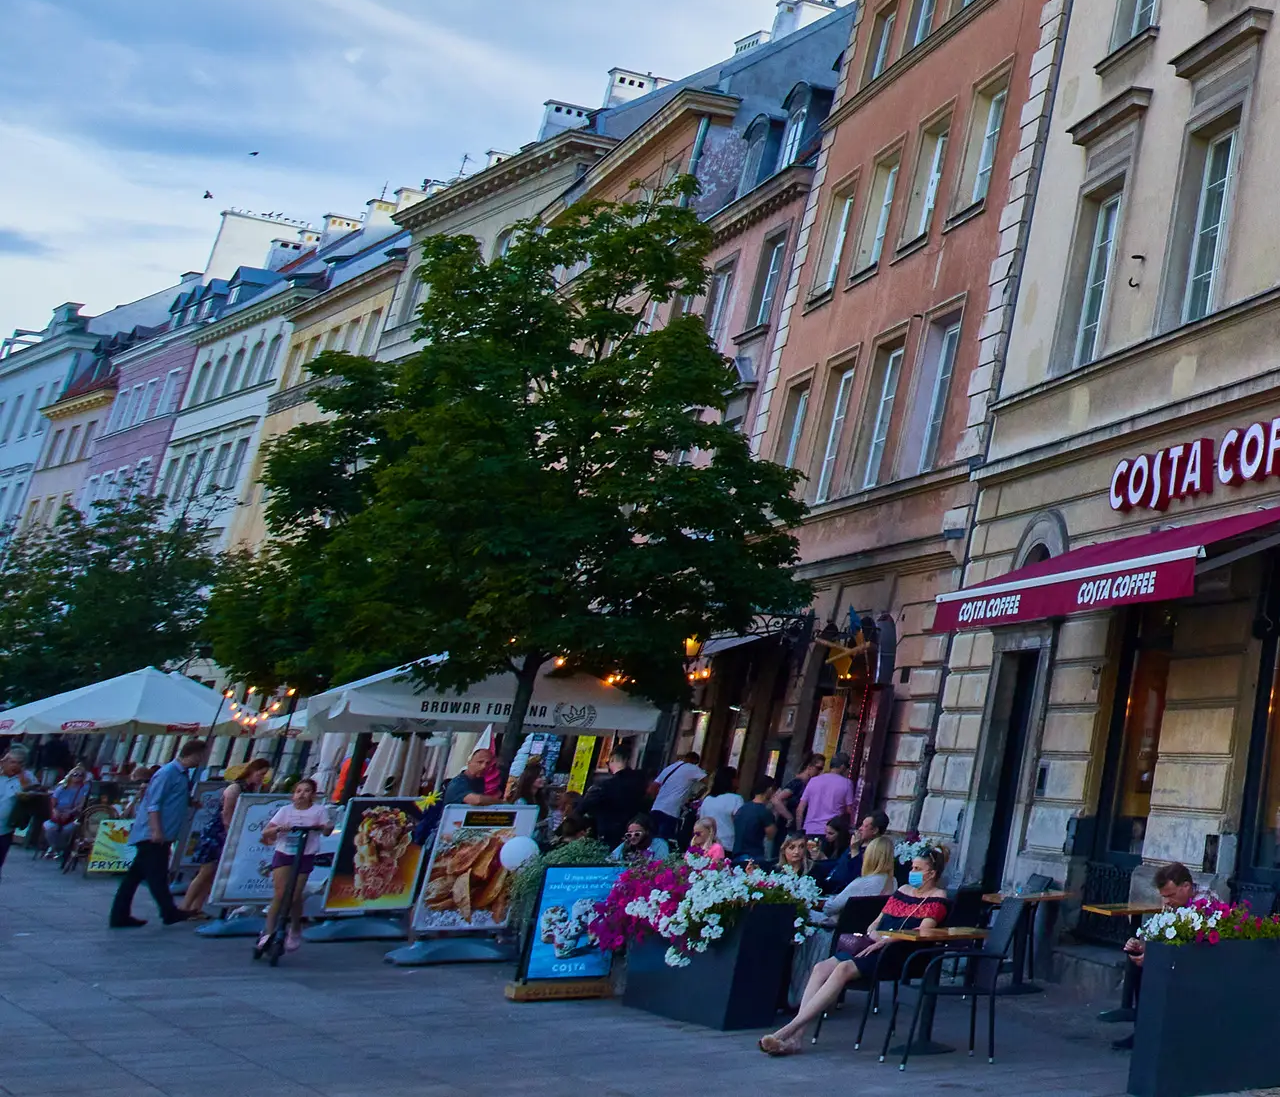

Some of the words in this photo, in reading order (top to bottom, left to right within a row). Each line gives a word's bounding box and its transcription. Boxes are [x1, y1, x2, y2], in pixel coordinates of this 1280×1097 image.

[1109, 439, 1210, 512] COSTA
[1077, 578, 1110, 605] COSTA
[1111, 570, 1157, 599] COFFEE
[958, 602, 985, 623] COSTA
[986, 594, 1021, 618] COFFEE
[420, 701, 481, 714] BROWAR
[486, 702, 548, 718] FORNA
[89, 860, 132, 870] FRYTK
[551, 963, 586, 972] COSTA
